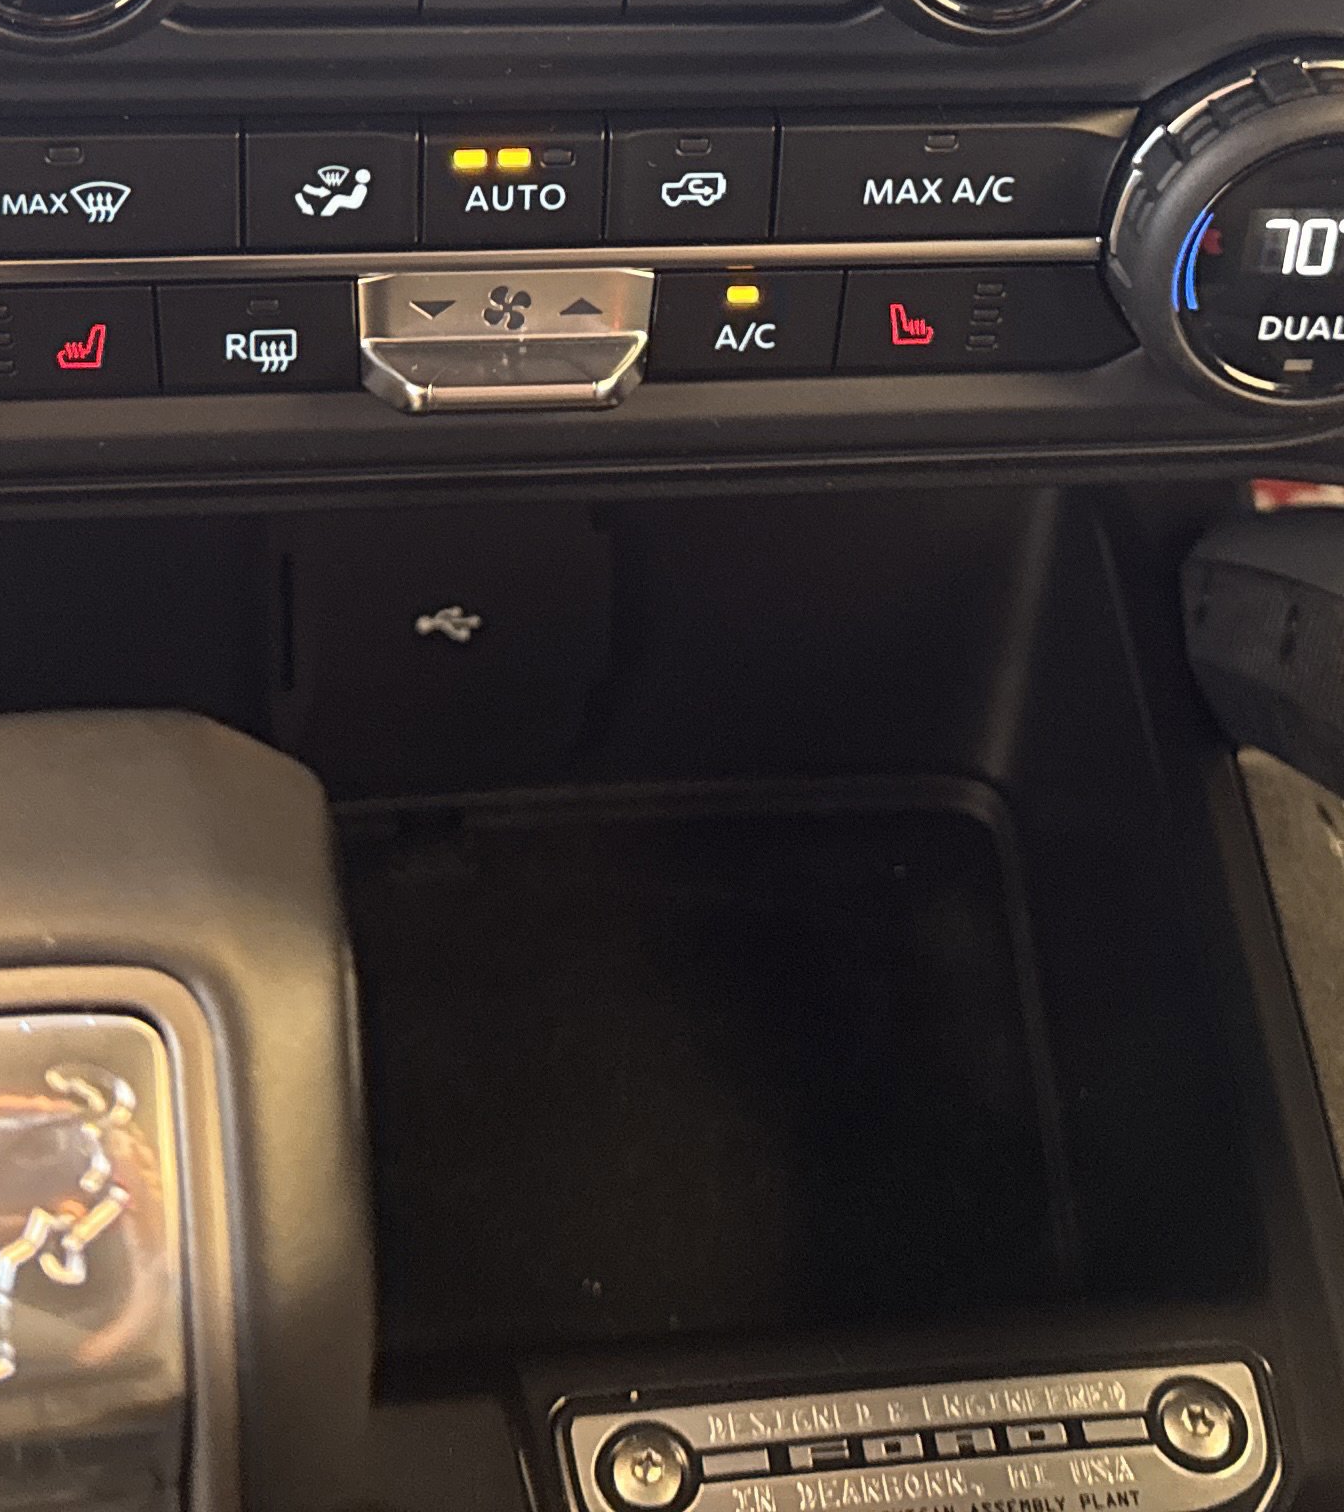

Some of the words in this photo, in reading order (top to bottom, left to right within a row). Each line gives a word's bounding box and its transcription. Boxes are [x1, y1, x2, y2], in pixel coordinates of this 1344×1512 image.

[1, 192, 68, 216] MAX
[464, 184, 567, 213] AUTO
[862, 177, 944, 206] MAX
[951, 175, 1016, 206] A/C
[713, 323, 777, 352] A/C
[788, 1421, 1068, 1470] FORD
[1069, 1454, 1136, 1486] USA
[1078, 1489, 1141, 1511] PLANT
